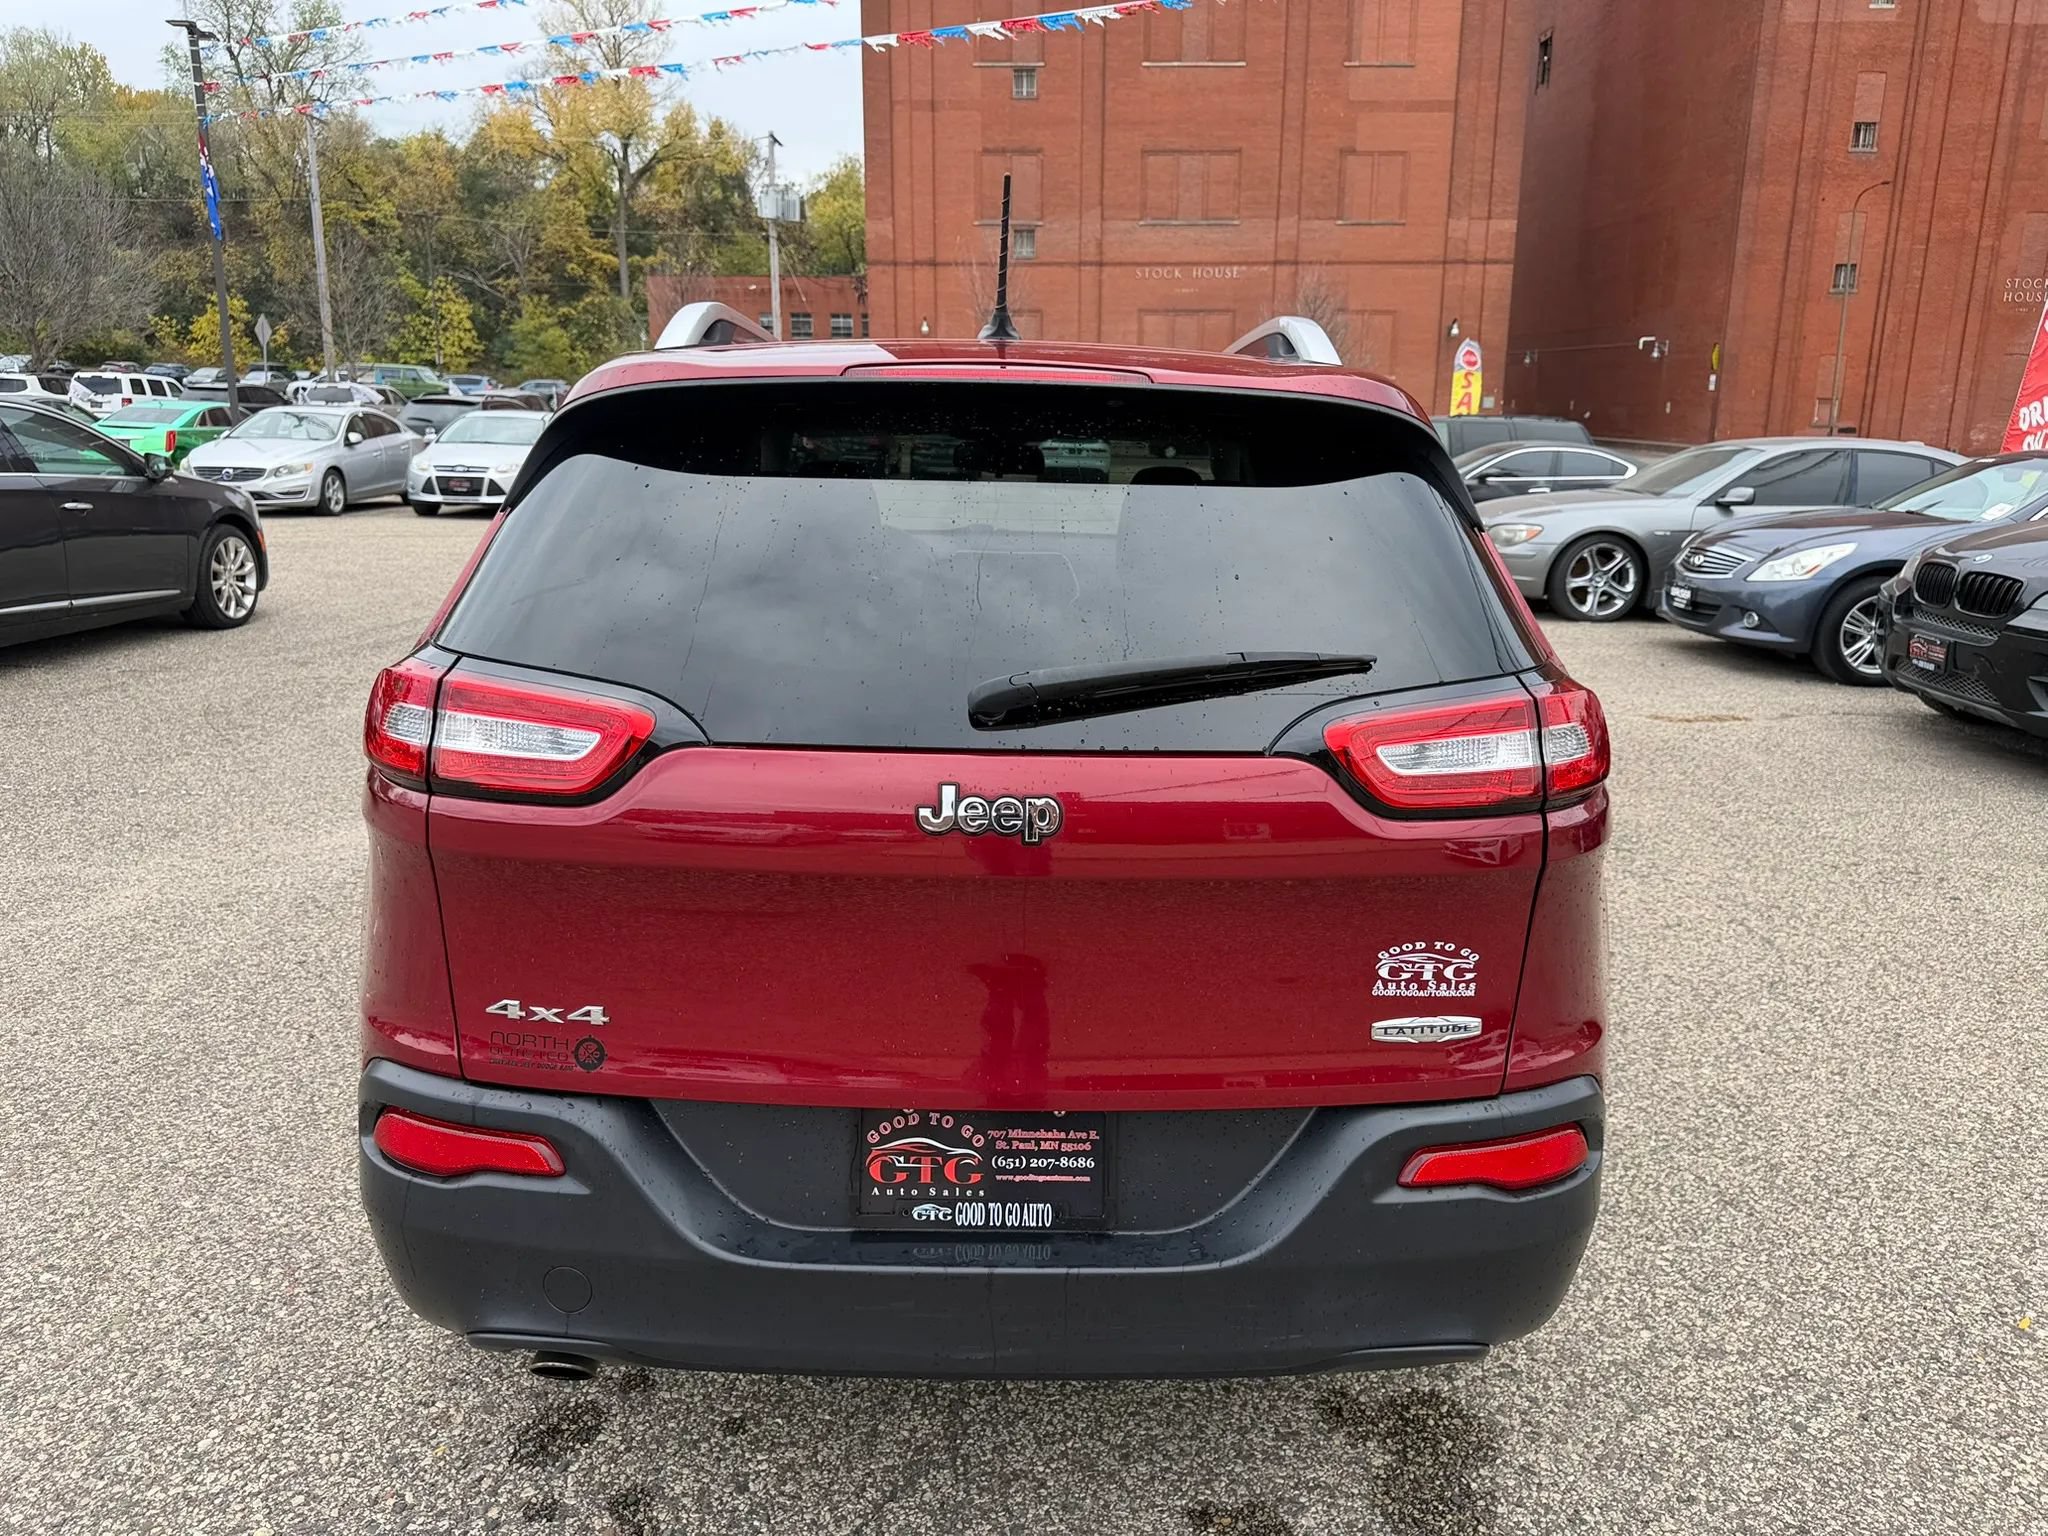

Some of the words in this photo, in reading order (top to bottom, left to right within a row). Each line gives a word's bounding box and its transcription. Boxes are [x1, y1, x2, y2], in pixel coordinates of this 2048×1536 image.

[1135, 266, 1182, 279] STOCK
[1192, 266, 1240, 279] HOUSE
[917, 783, 1062, 844] Jeep
[1377, 941, 1427, 959] GOOD
[1434, 941, 1456, 952] TO
[1460, 948, 1480, 961] GO
[1377, 962, 1478, 981] GTG
[1371, 989, 1475, 997] GOODTOGOAUTOMN.COM
[1373, 980, 1418, 990] Auto
[1427, 980, 1477, 991] Sales
[485, 999, 610, 1026] 4x4
[1382, 1023, 1472, 1036] LATITUDE
[867, 1112, 920, 1144] GOOD
[929, 1112, 955, 1129] TO
[961, 1125, 985, 1148] GO
[987, 1130, 1006, 1139] 707
[1008, 1128, 1067, 1139] Minnehaha
[1068, 1130, 1088, 1139] Ave
[1089, 1130, 1100, 1140] E.
[995, 1140, 1010, 1150] St.
[1011, 1140, 1039, 1151] Paul,
[1040, 1141, 1060, 1150] MN
[1060, 1142, 1092, 1152] 55106
[867, 1155, 985, 1185] GTG
[991, 1155, 1027, 1169] (651)
[1029, 1156, 1095, 1170] 207-8686
[872, 1187, 919, 1197] Auto
[929, 1187, 985, 1197] Sales
[912, 1206, 953, 1221] GTG
[955, 1202, 986, 1226] GOOD
[988, 1202, 1003, 1227] TO
[1004, 1203, 1021, 1227] GO
[1021, 1203, 1053, 1228] AUTO
